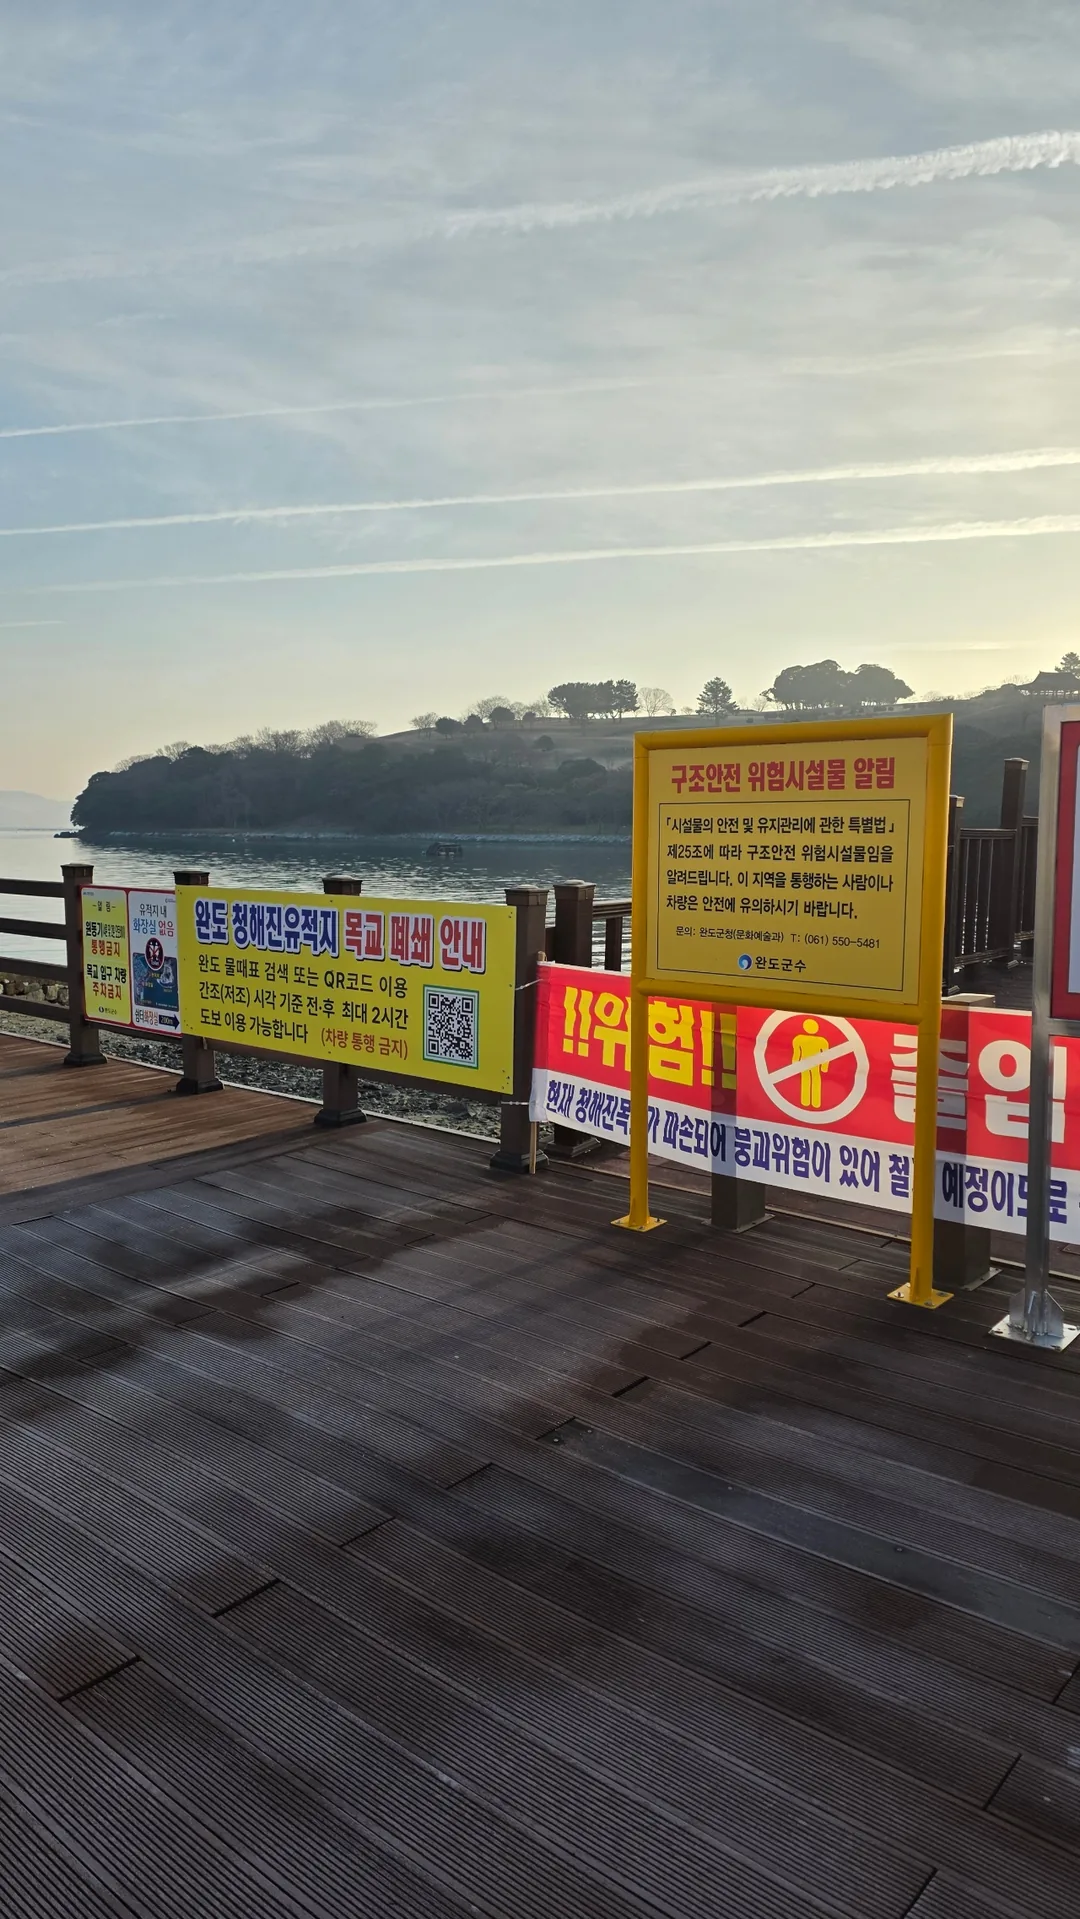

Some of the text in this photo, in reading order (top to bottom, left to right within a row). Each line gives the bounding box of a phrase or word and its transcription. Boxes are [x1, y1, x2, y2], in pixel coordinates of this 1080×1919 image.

[671, 756, 896, 794] 구조안전 위험시설물 알림
[716, 817, 739, 834] 안전
[743, 817, 754, 834] 및
[757, 817, 816, 834] 유지관리에
[819, 816, 845, 834] 관한
[667, 844, 894, 863] 제25조에 따라 구조안전 위험시설물임을
[666, 869, 894, 892] 알려드립니다. 이 지역을 통행하는 사람이나
[139, 903, 167, 918] 유적지 내
[666, 895, 858, 920] 차량은 안전에 유의하시기 바랍니다.
[132, 917, 157, 935] 화장실
[158, 920, 175, 937] 없음
[195, 900, 483, 969] 완도 청해진유적지 목교 폐쇄 안내
[675, 926, 881, 949] 문의: 완도군청(문화예술과) T: (061) 550-5481
[91, 938, 121, 958] 통행금지
[86, 963, 127, 984] 목교 입구 차량
[754, 956, 807, 973] 완도군수
[198, 954, 408, 999] 완도 물때표 검색 또는 QR코드 이용
[92, 981, 122, 1001] 주차금지
[199, 981, 250, 1008] 간조(저조)
[253, 988, 277, 1010] 시각
[279, 992, 303, 1014] 기준
[342, 1001, 368, 1025] 최대
[371, 1006, 409, 1030] 2시간
[200, 1008, 408, 1061] 도보 이용 가능합니다 (차량 통행 금지)
[546, 1079, 576, 1118] 현재
[576, 1087, 660, 1144] 청해진목가
[663, 1110, 727, 1162] 파손되어
[734, 1126, 831, 1183] 붕괴위험이
[839, 1145, 881, 1192] 있어
[888, 1154, 915, 1198] 철
